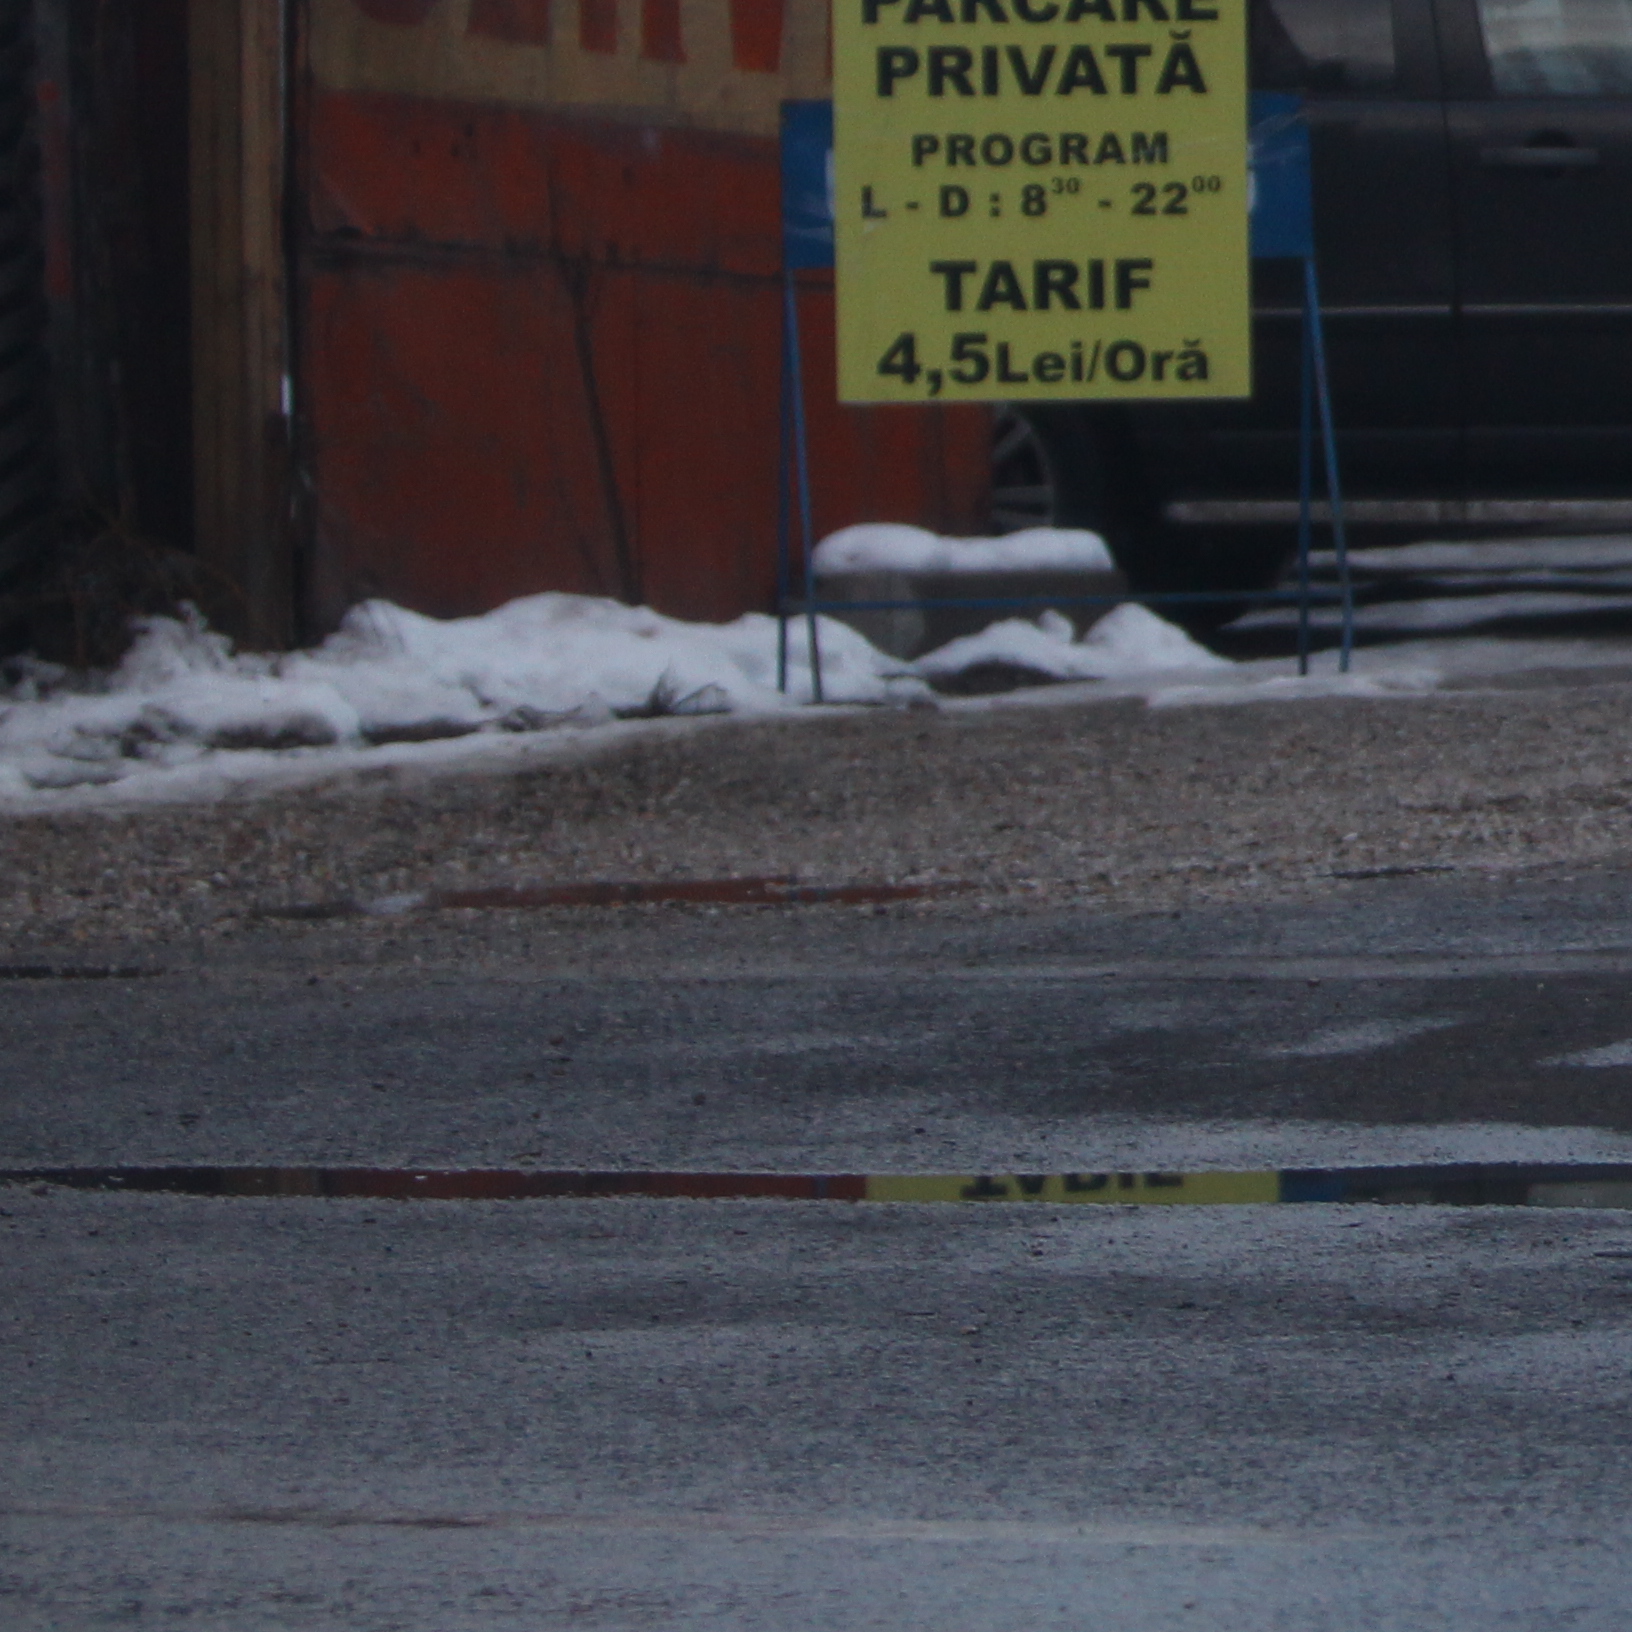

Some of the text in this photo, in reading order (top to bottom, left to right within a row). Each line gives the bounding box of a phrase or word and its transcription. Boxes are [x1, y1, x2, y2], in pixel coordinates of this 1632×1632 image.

[876, 29, 1207, 98] PRIVATĂ
[911, 131, 1169, 167] PROGRAM
[930, 257, 1154, 312] TARIF
